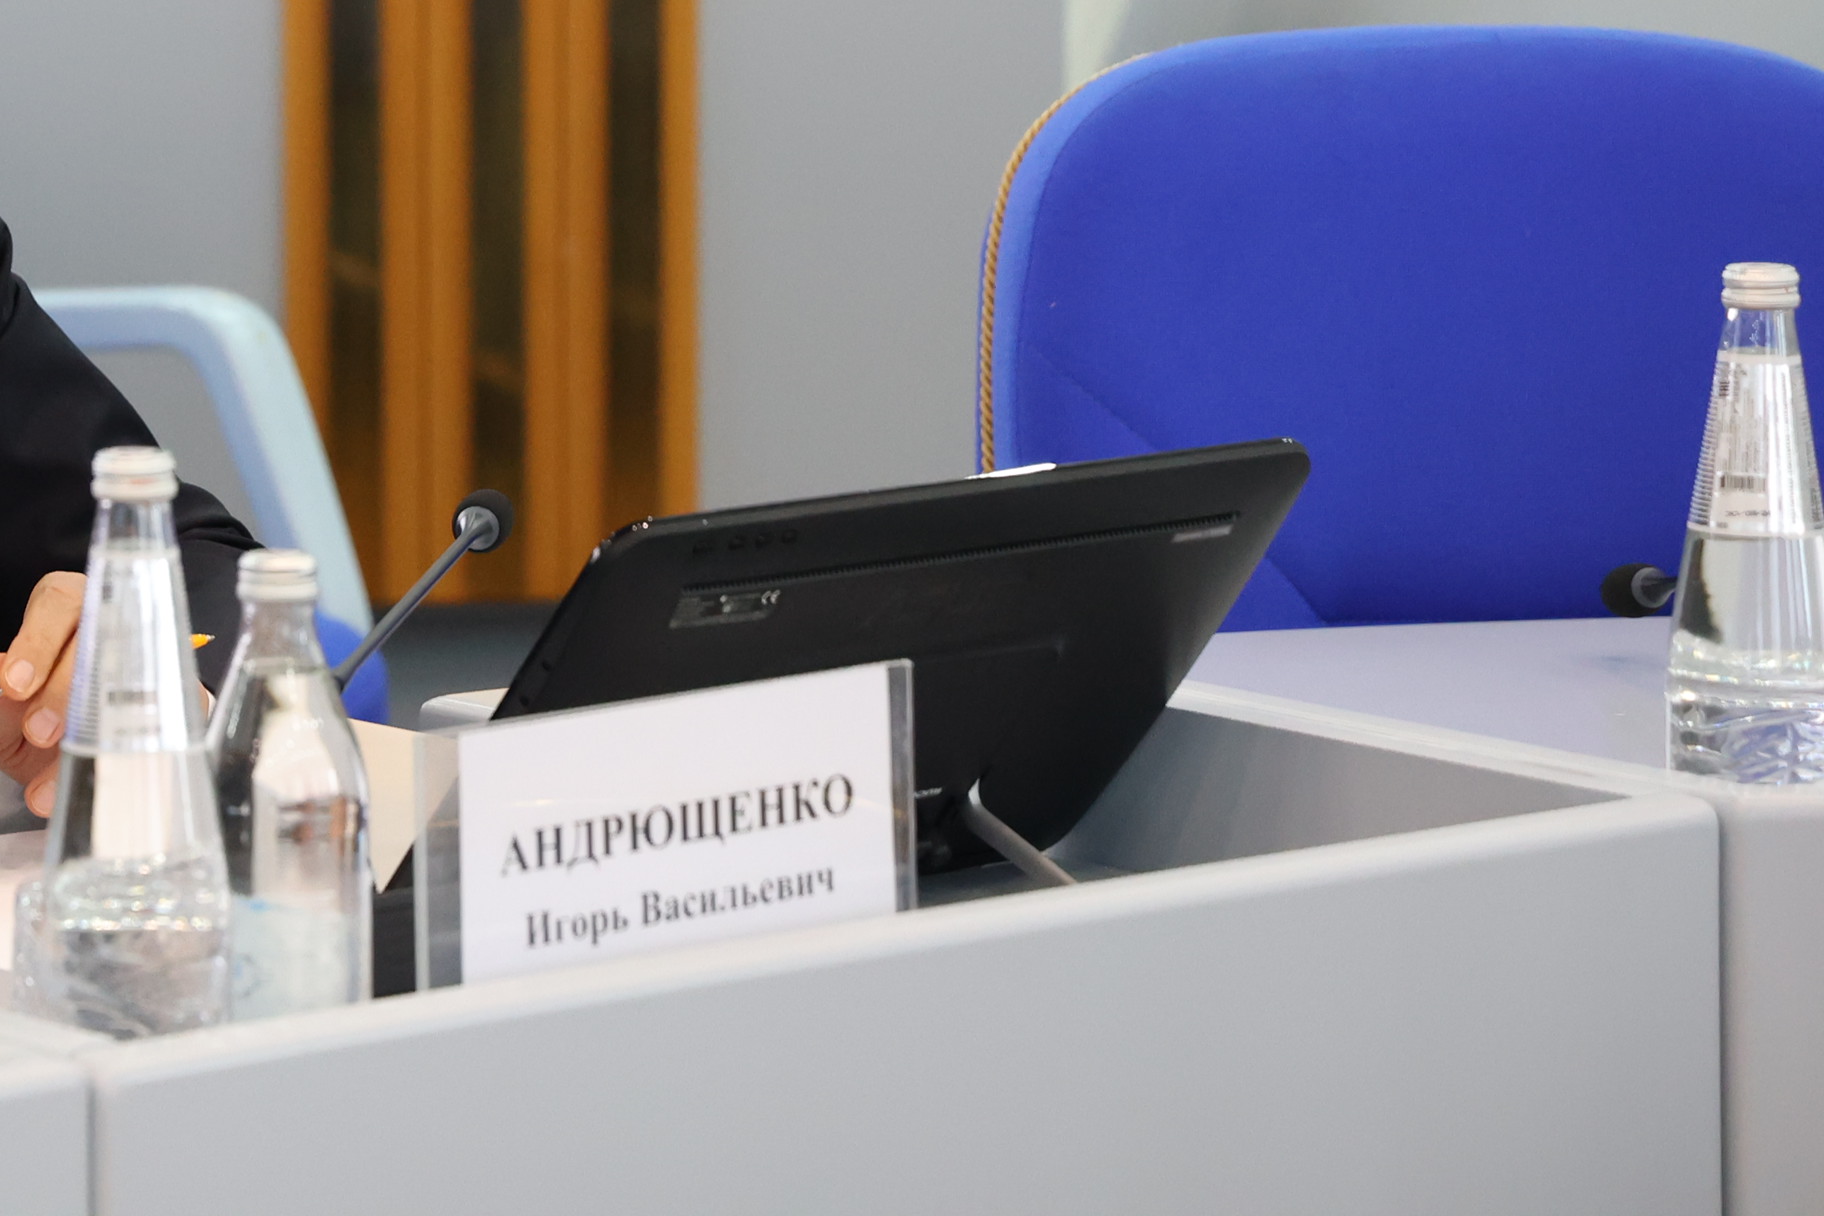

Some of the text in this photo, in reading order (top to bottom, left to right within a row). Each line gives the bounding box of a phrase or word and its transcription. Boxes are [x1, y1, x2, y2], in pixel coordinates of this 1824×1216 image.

[501, 773, 855, 876] АНДРЮЩЕНКО
[526, 868, 835, 949] Игорь Васильевич
